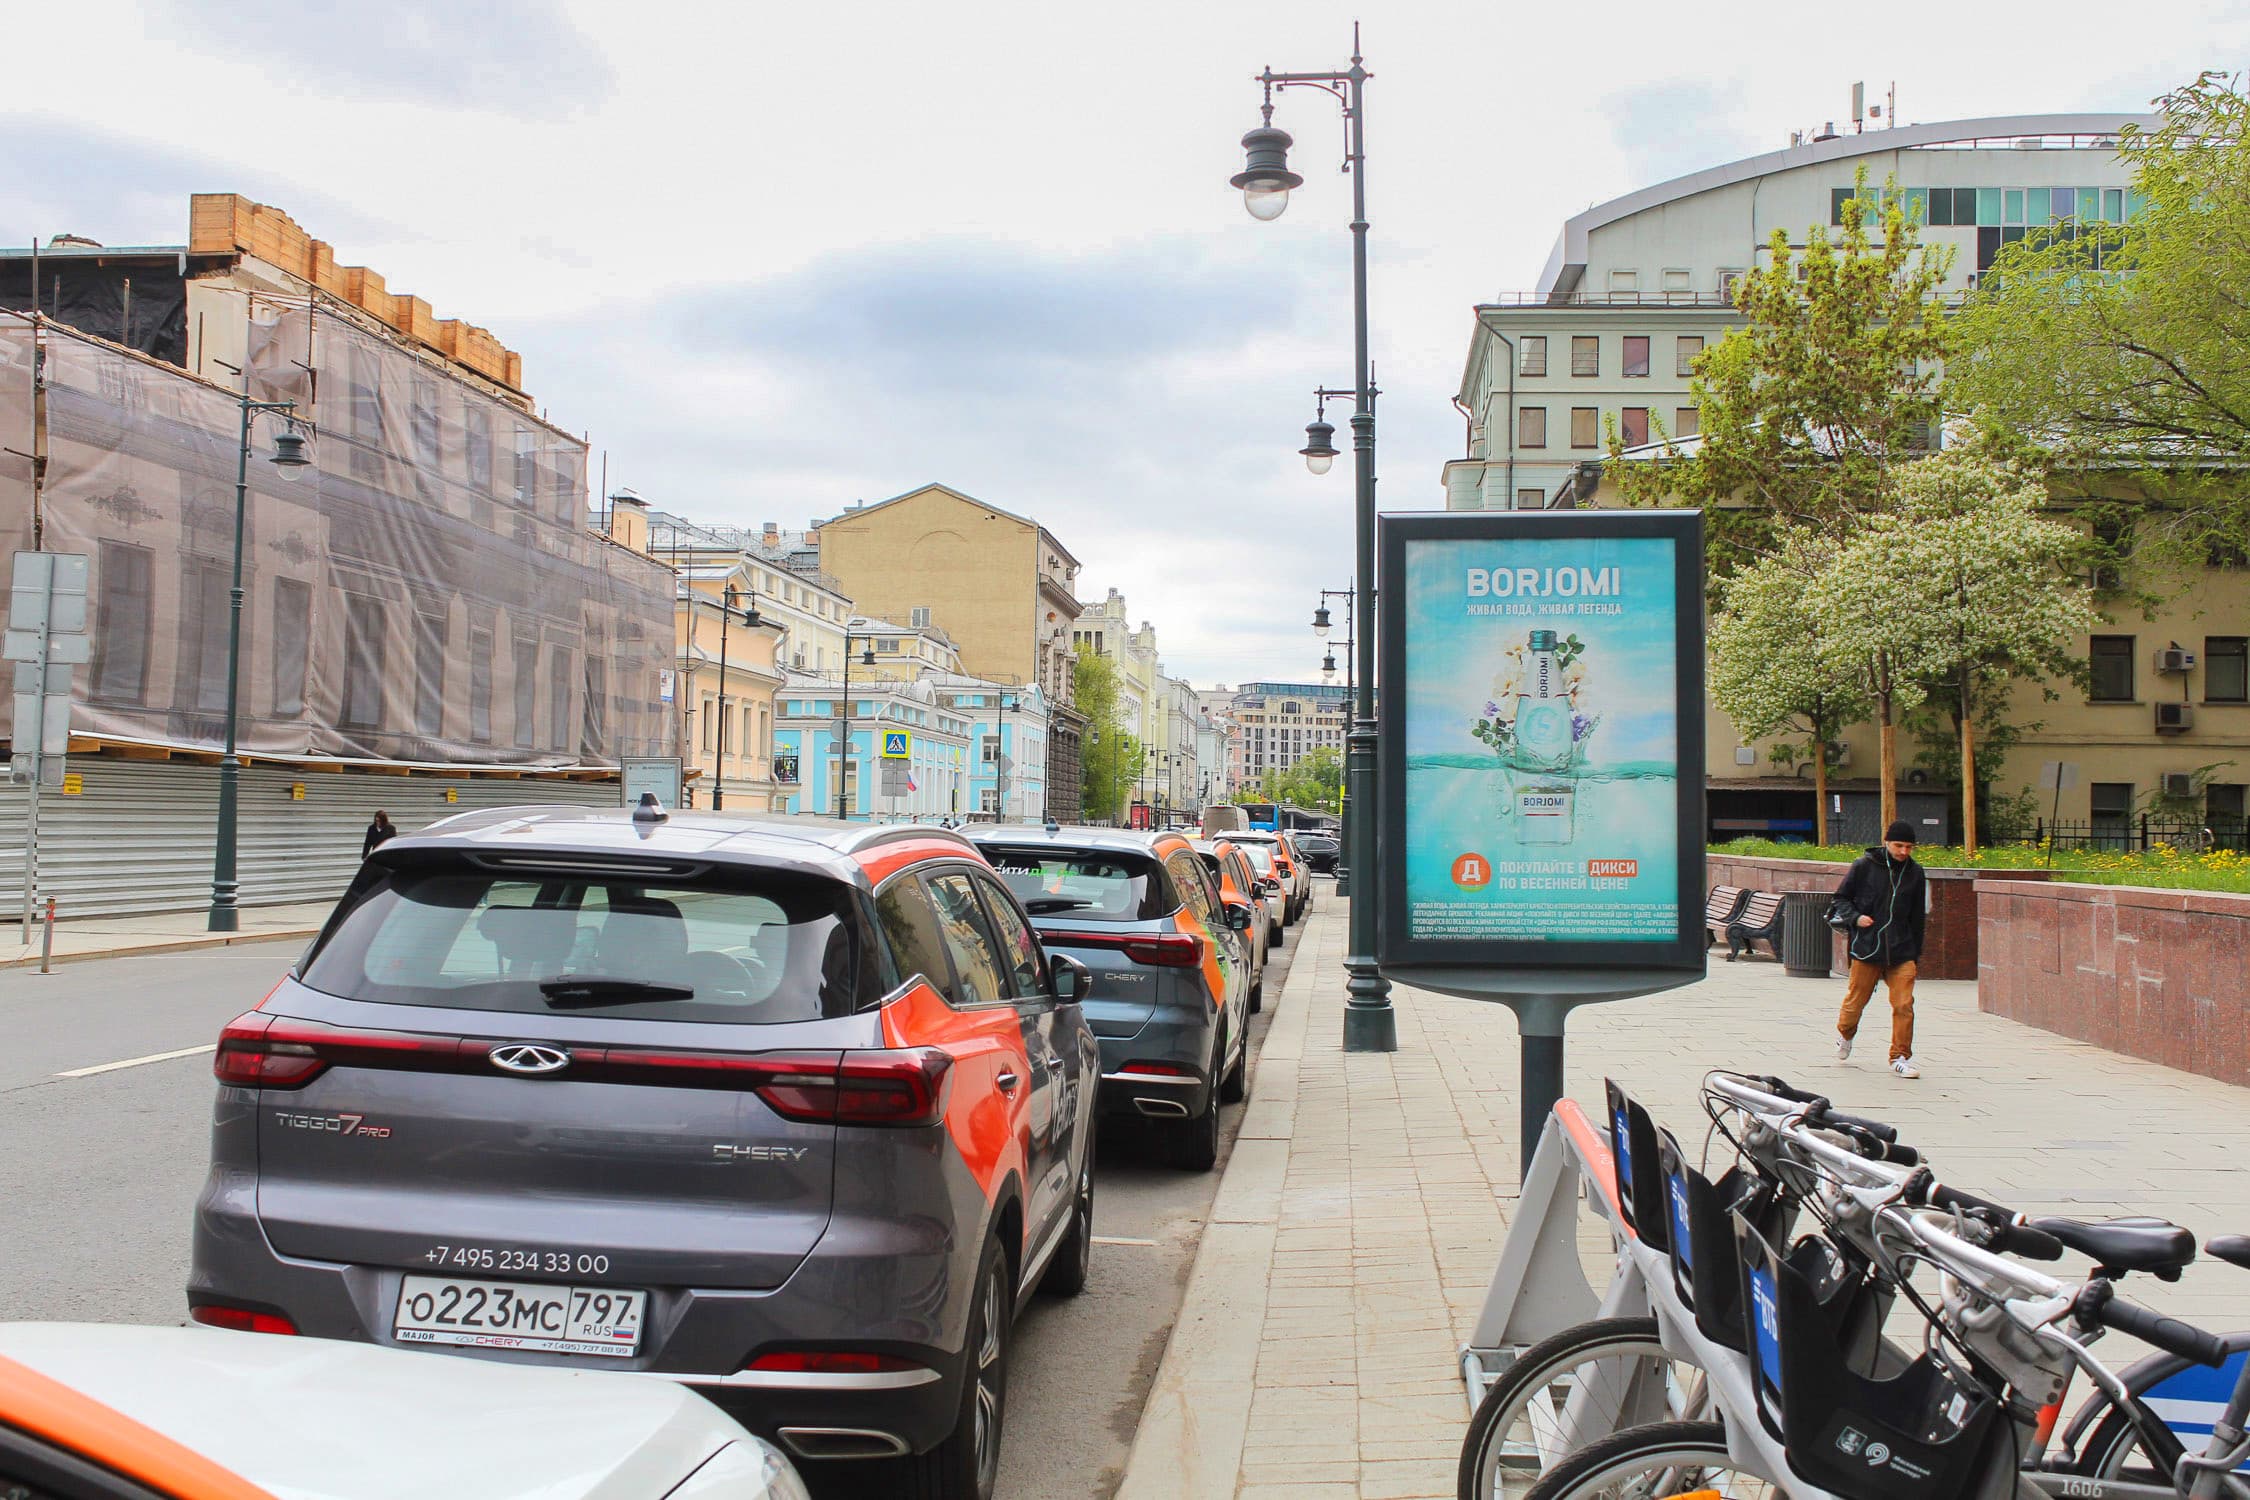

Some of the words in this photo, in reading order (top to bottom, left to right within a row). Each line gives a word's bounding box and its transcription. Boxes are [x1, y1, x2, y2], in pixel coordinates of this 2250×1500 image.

[1466, 566, 1620, 598] BORJOMI
[1466, 603, 1503, 616] ЖИВАЯ
[1505, 603, 1536, 617] ВОДА,
[1538, 603, 1575, 616] ЖИВАЯ
[1577, 602, 1623, 616] ЛЕГЕНДА
[1539, 657, 1549, 699] BORJOMI
[1523, 796, 1565, 807] BORJOMI
[1461, 859, 1481, 882] Д
[1499, 859, 1575, 874] ПОКУПАЙТЕ
[1578, 861, 1588, 874] В
[1589, 861, 1637, 876] ДИКСИ
[1499, 877, 1516, 890] ПО
[1520, 875, 1588, 890] ВЕСЕННЕЙ
[1591, 877, 1630, 892] ЦЕНЕ!
[1104, 972, 1147, 982] CHERY
[357, 1126, 392, 1138] PRO
[713, 1144, 809, 1161] CHERY
[425, 1246, 449, 1266] +7
[453, 1248, 494, 1269] 495
[499, 1250, 540, 1272] 234
[544, 1252, 571, 1273] 33
[576, 1254, 610, 1275] 00
[573, 1292, 634, 1326] 797
[401, 1331, 436, 1341] MAJOR
[475, 1336, 523, 1347] CHERY
[582, 1324, 613, 1337] RUS
[2061, 1479, 2103, 1498] 1606
